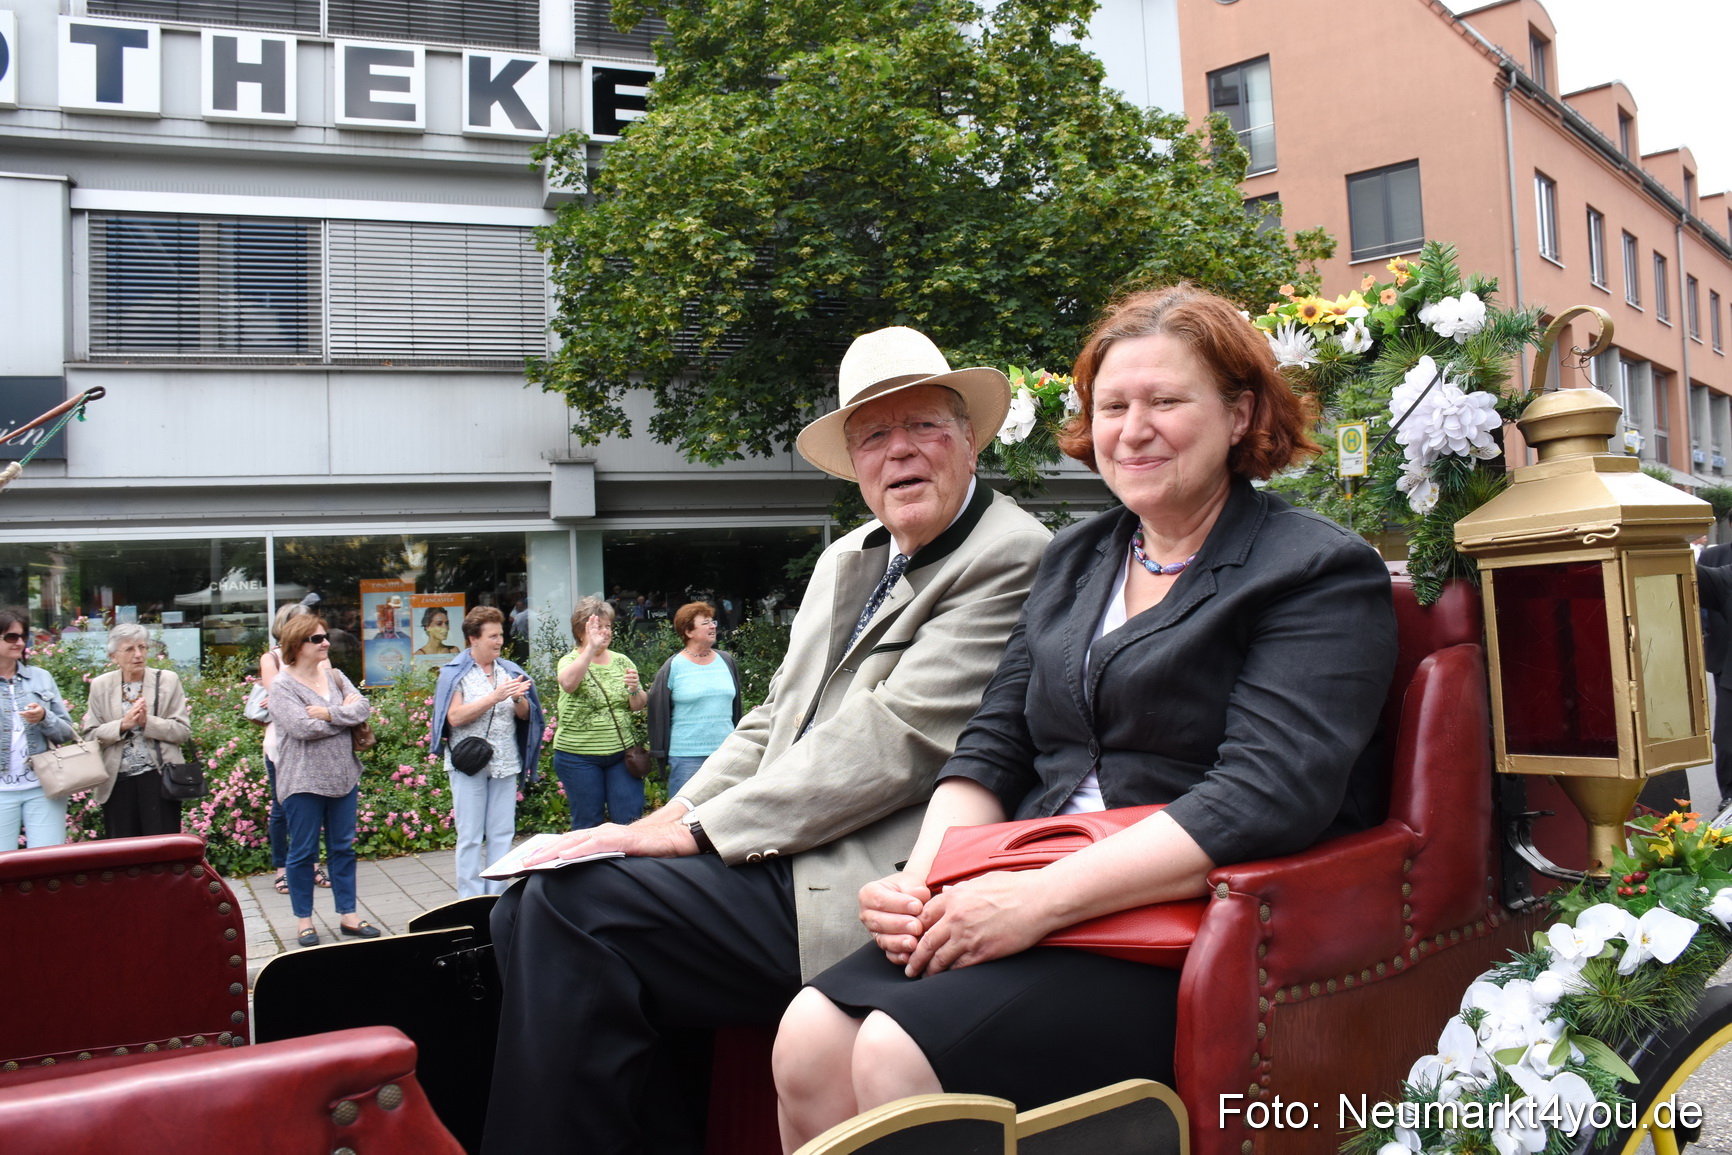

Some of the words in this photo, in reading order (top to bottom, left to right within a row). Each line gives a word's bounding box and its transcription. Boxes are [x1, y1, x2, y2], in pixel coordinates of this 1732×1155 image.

[0, 22, 655, 136] THEKE
[1347, 434, 1357, 448] H
[209, 580, 267, 591] CHANEL
